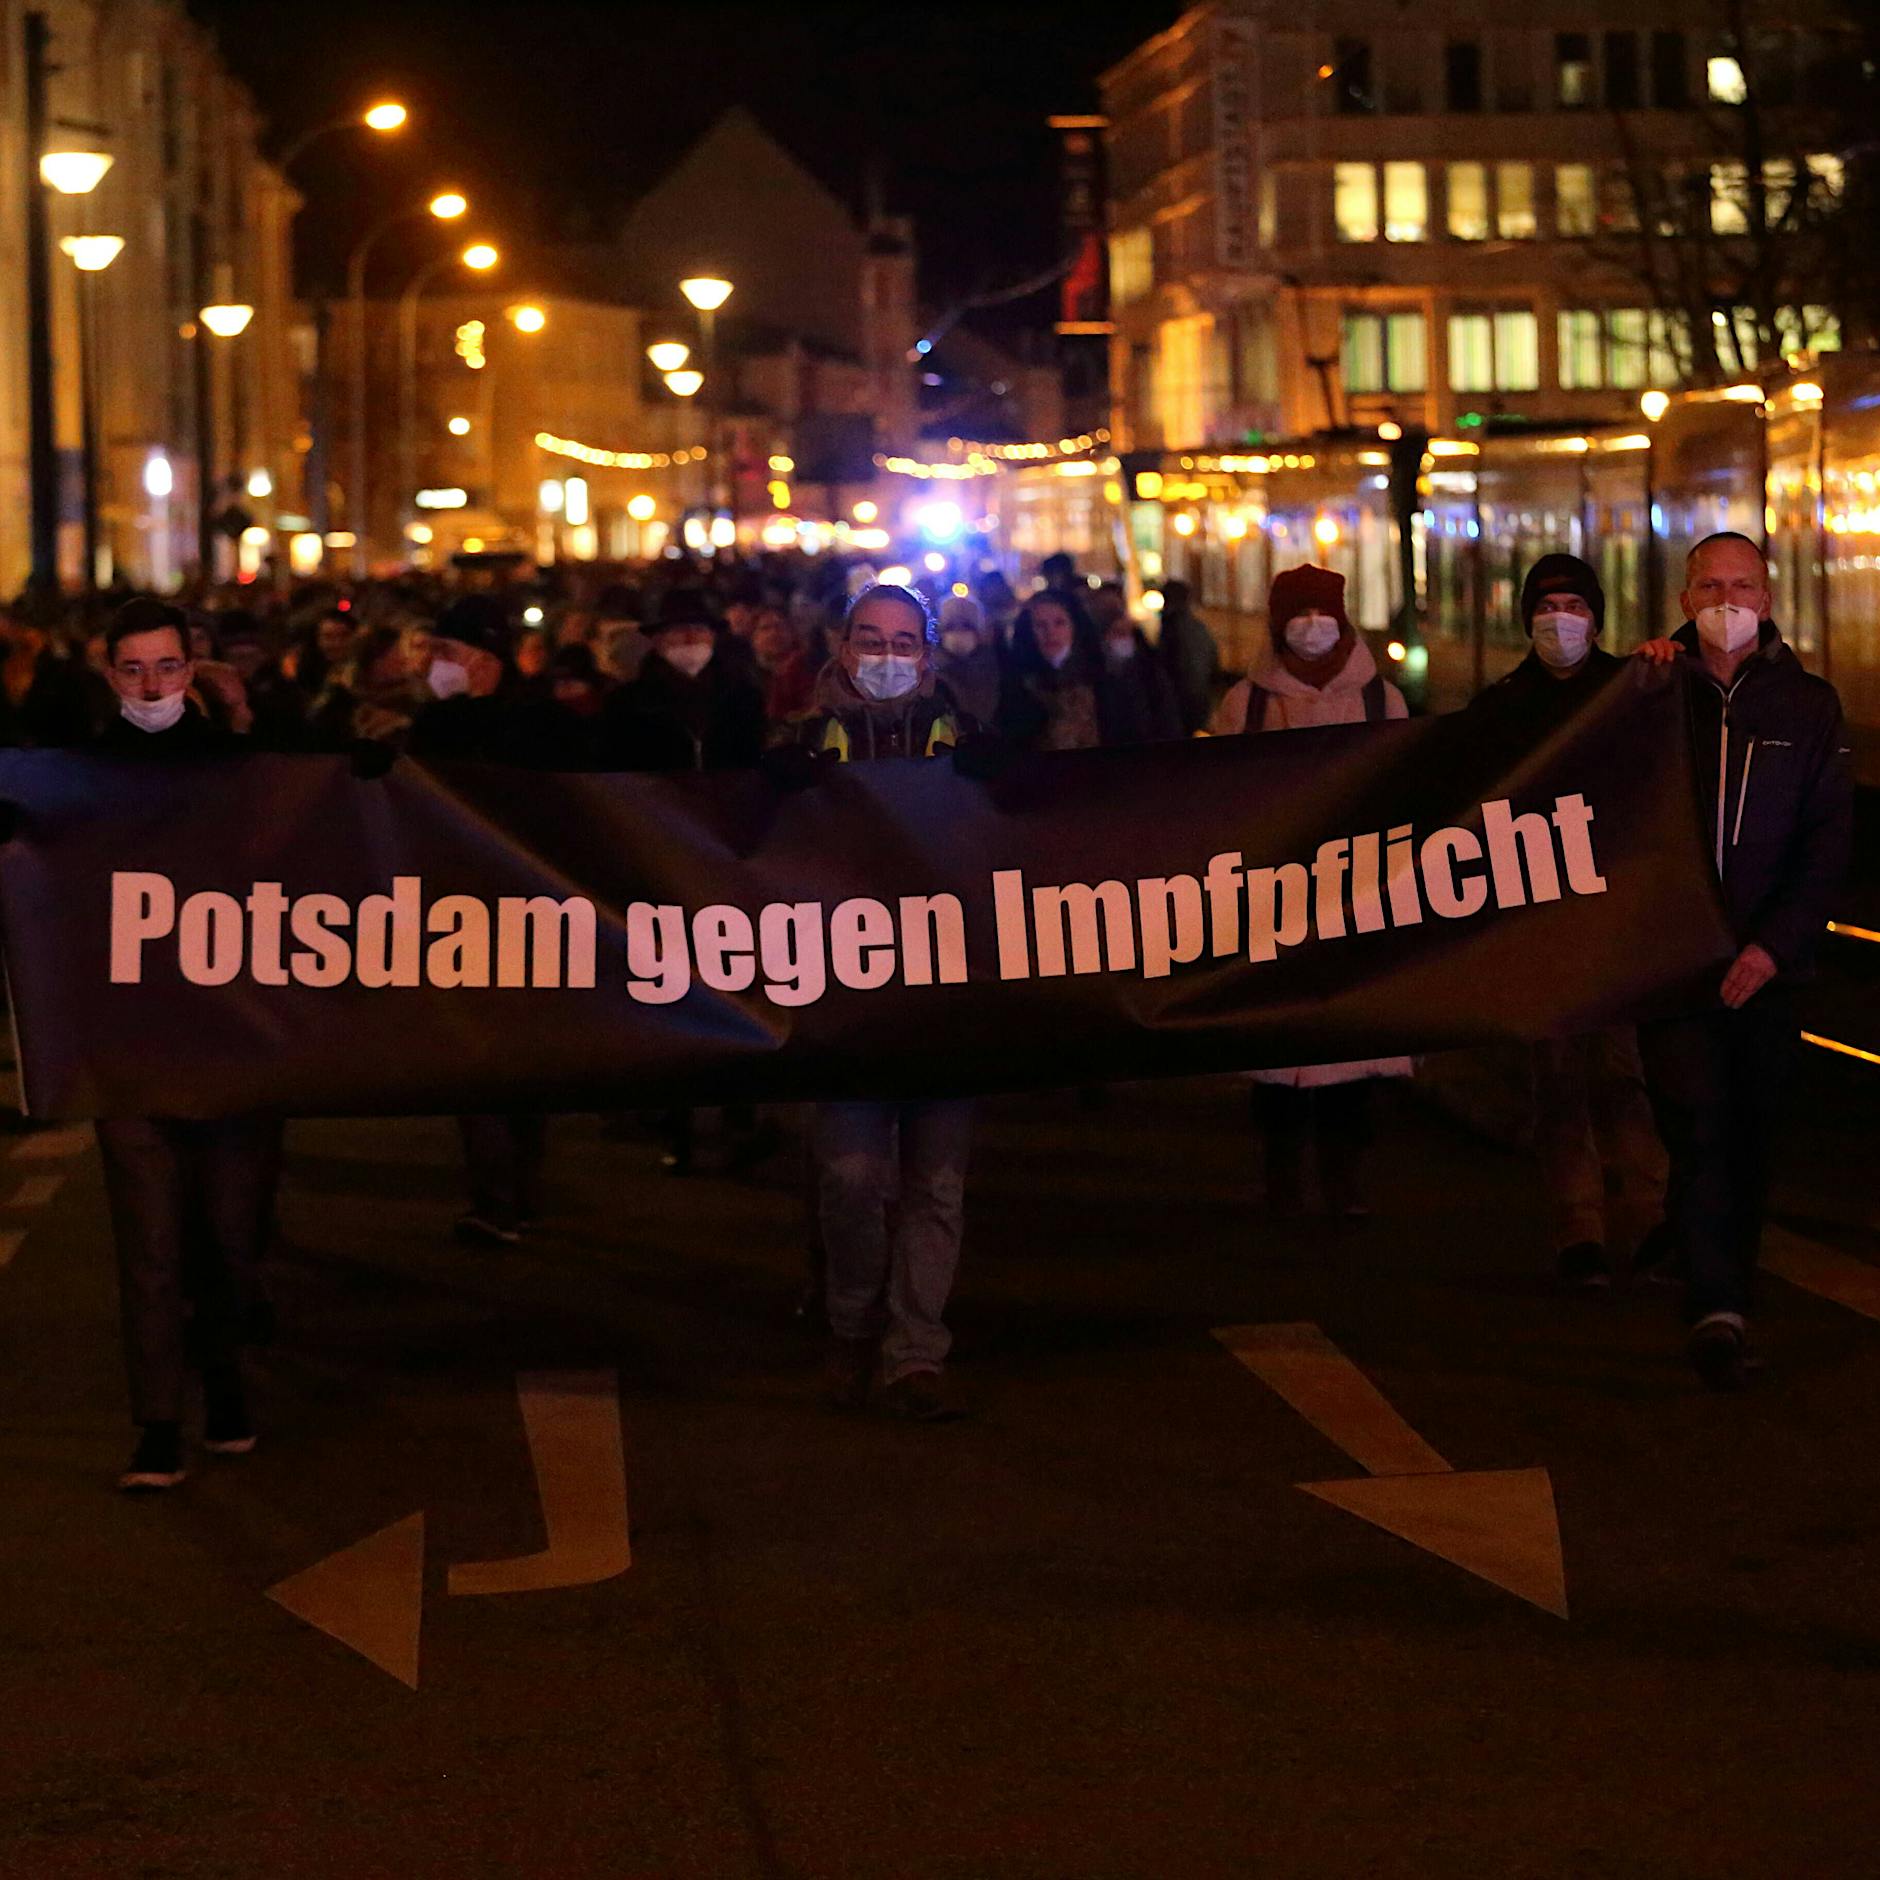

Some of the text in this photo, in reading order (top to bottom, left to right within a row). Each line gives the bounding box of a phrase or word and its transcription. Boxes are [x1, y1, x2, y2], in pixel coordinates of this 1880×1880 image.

[109, 793, 1607, 1008] Potsdam gegen Impfpflicht
